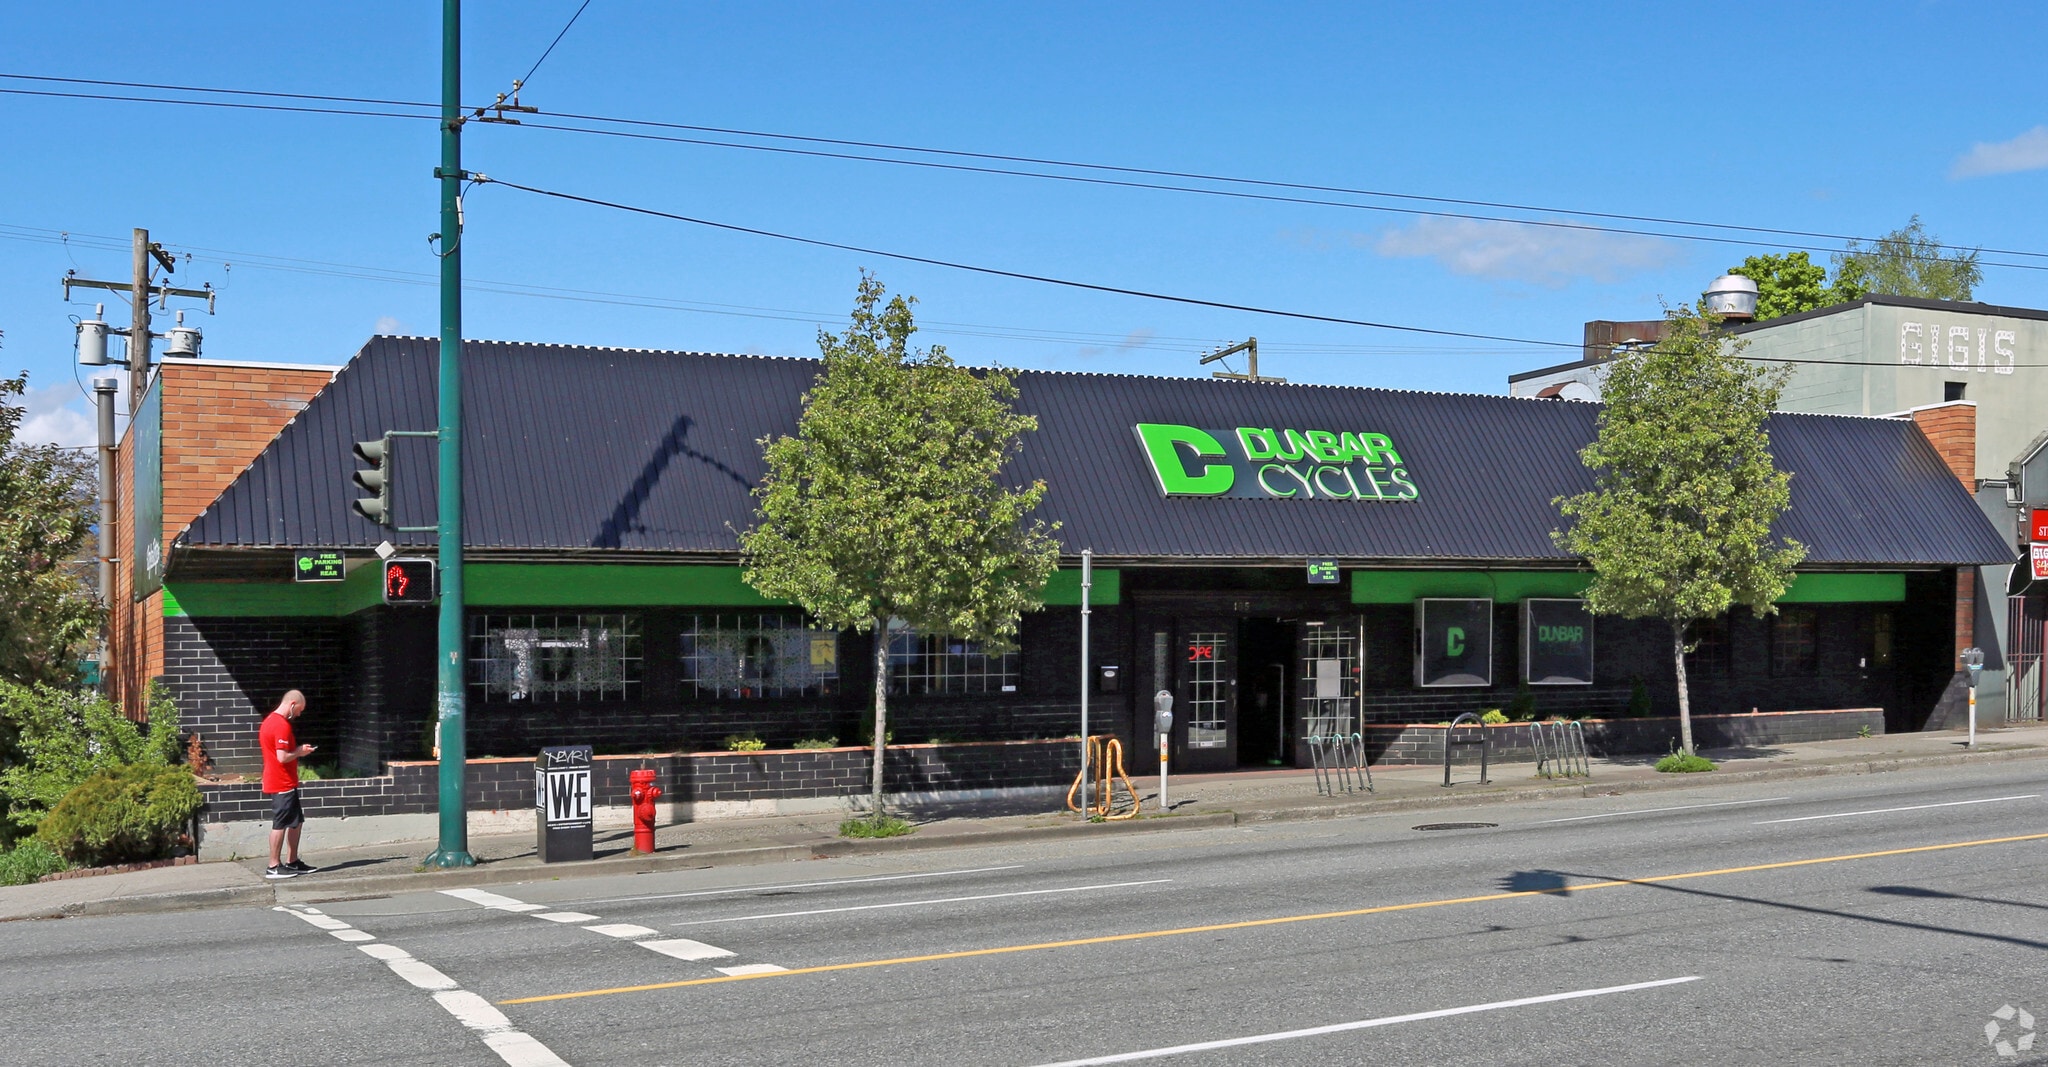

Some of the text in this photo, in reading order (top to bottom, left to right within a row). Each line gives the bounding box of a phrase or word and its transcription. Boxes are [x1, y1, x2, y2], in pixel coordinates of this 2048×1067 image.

[1235, 427, 1403, 466] DUNBAR
[1258, 463, 1419, 501] CYCLES
[1538, 625, 1583, 642] DUNBAR
[550, 772, 588, 819] WE
